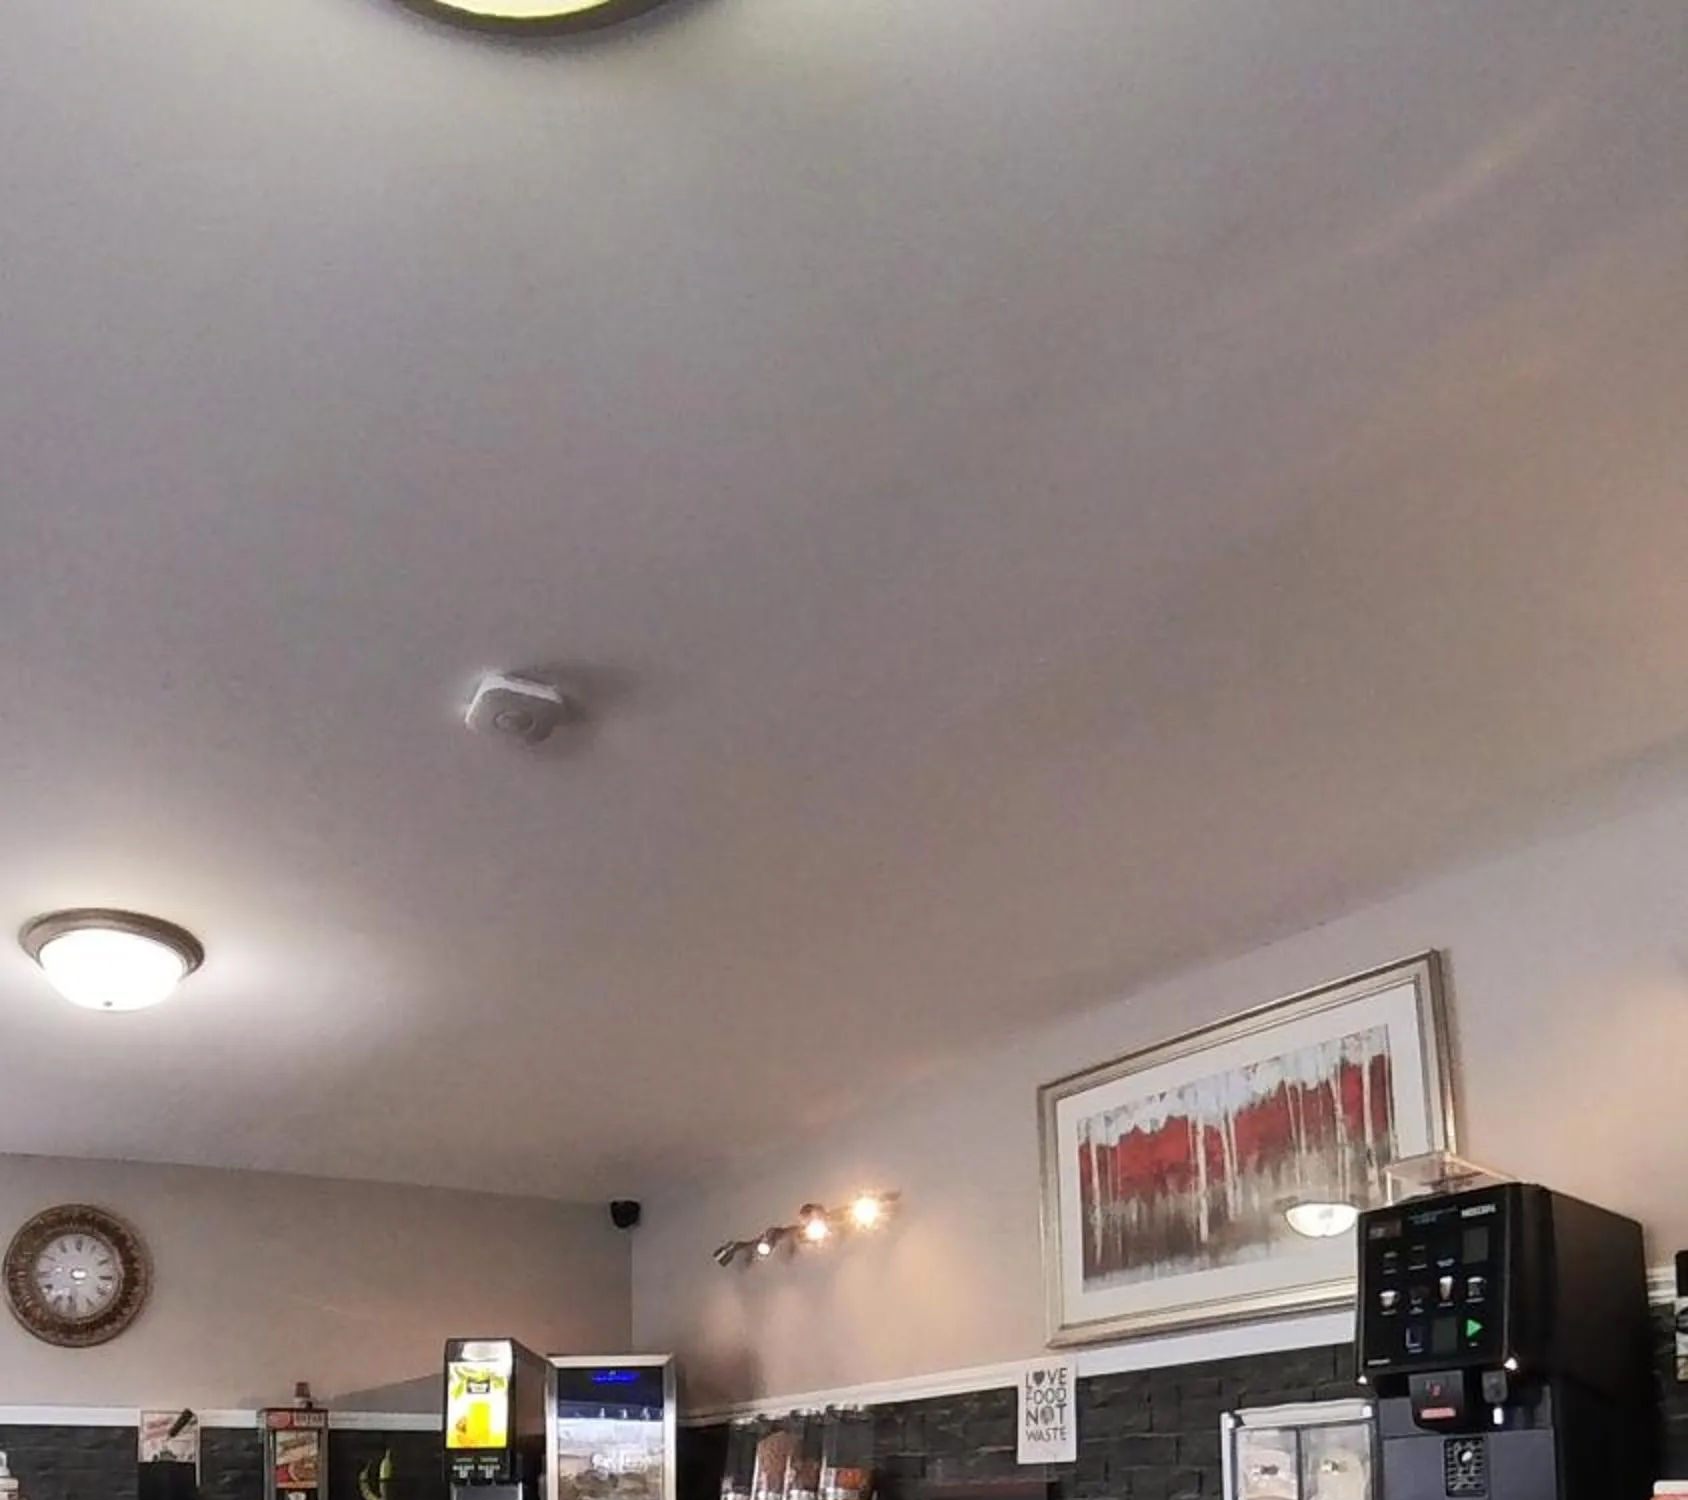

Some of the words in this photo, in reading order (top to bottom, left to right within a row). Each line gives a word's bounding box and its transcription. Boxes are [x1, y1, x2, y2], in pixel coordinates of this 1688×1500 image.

[1025, 1387, 1067, 1406] FOOD
[1025, 1403, 1067, 1426] NOT
[1025, 1426, 1067, 1442] WASTE
